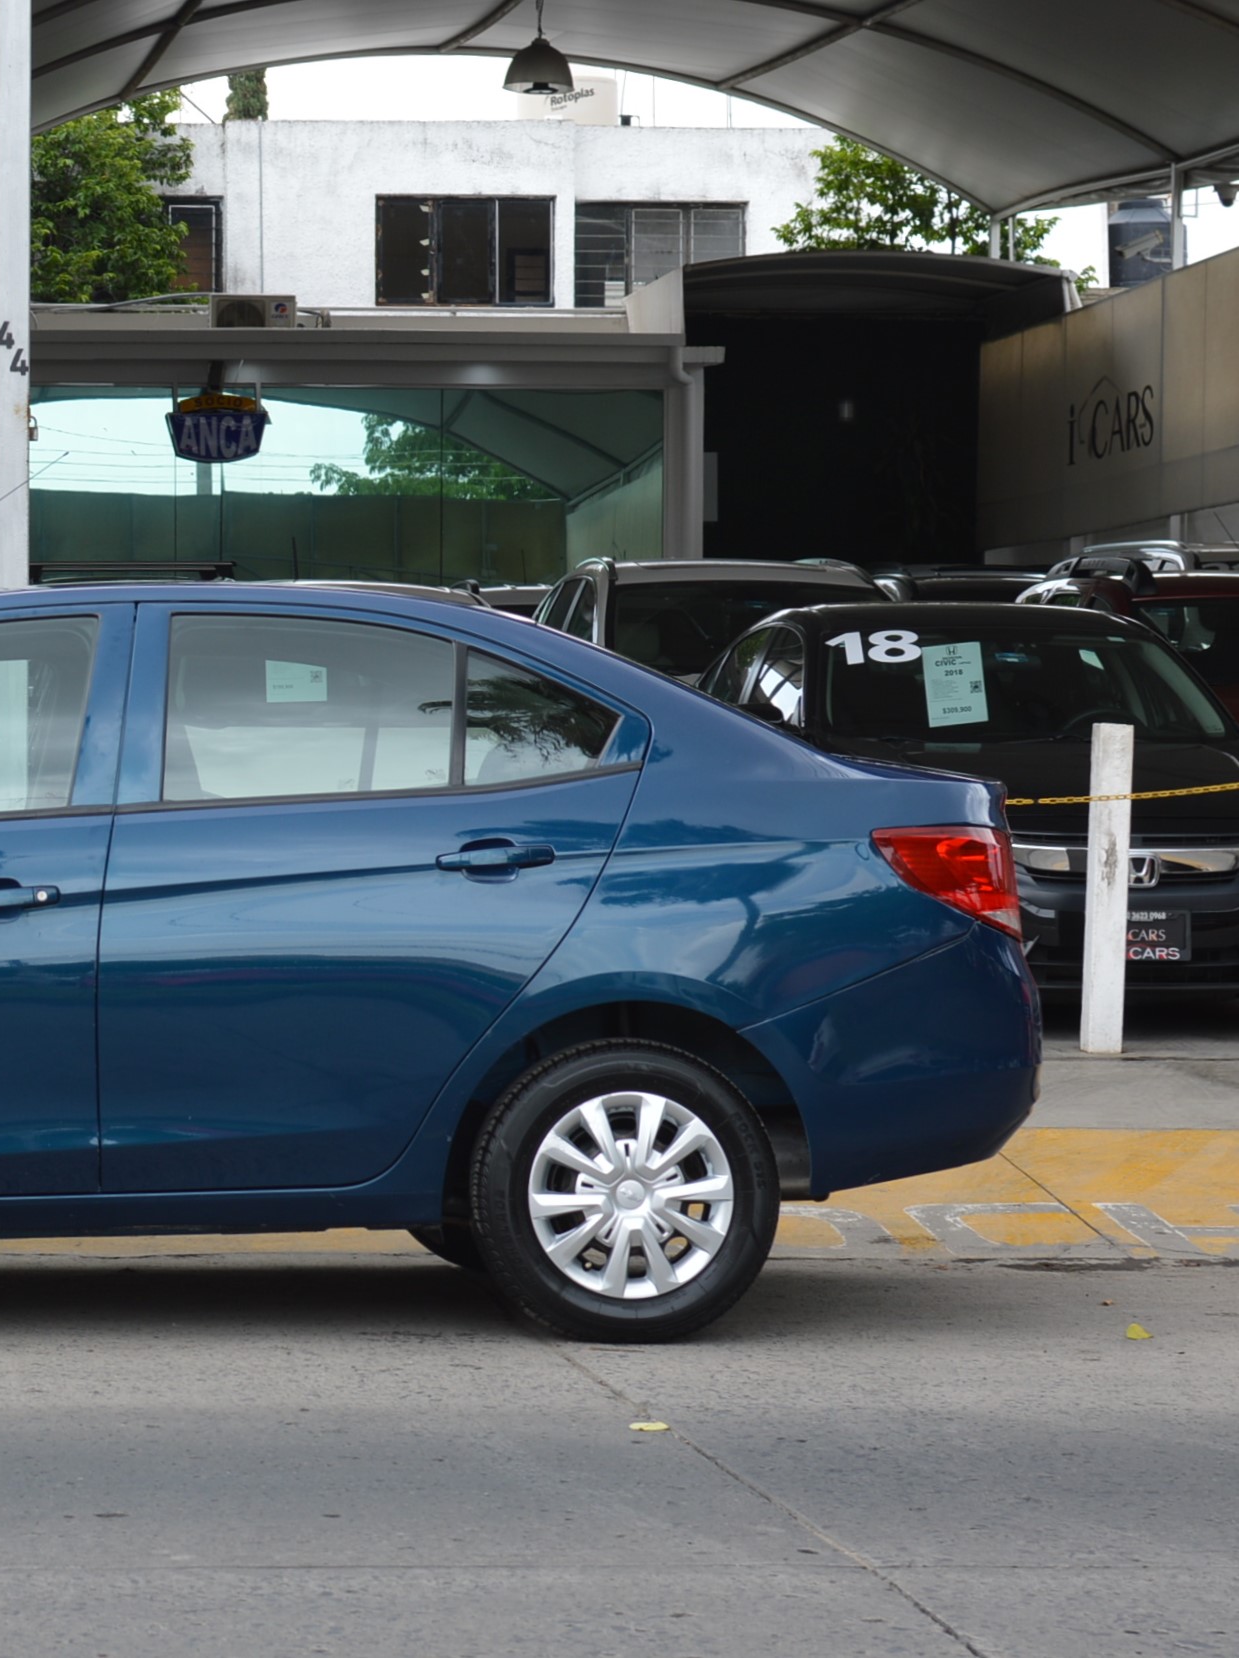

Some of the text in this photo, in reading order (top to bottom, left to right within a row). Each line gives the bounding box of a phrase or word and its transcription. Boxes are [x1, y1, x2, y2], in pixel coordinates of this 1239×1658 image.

[550, 88, 595, 107] Rotoplas
[194, 397, 242, 407] SOCIO
[1088, 384, 1154, 459] CARS
[180, 416, 257, 458] ANCA
[825, 629, 922, 666] 18
[1127, 929, 1166, 941] CARS
[1128, 947, 1180, 960] CARS
